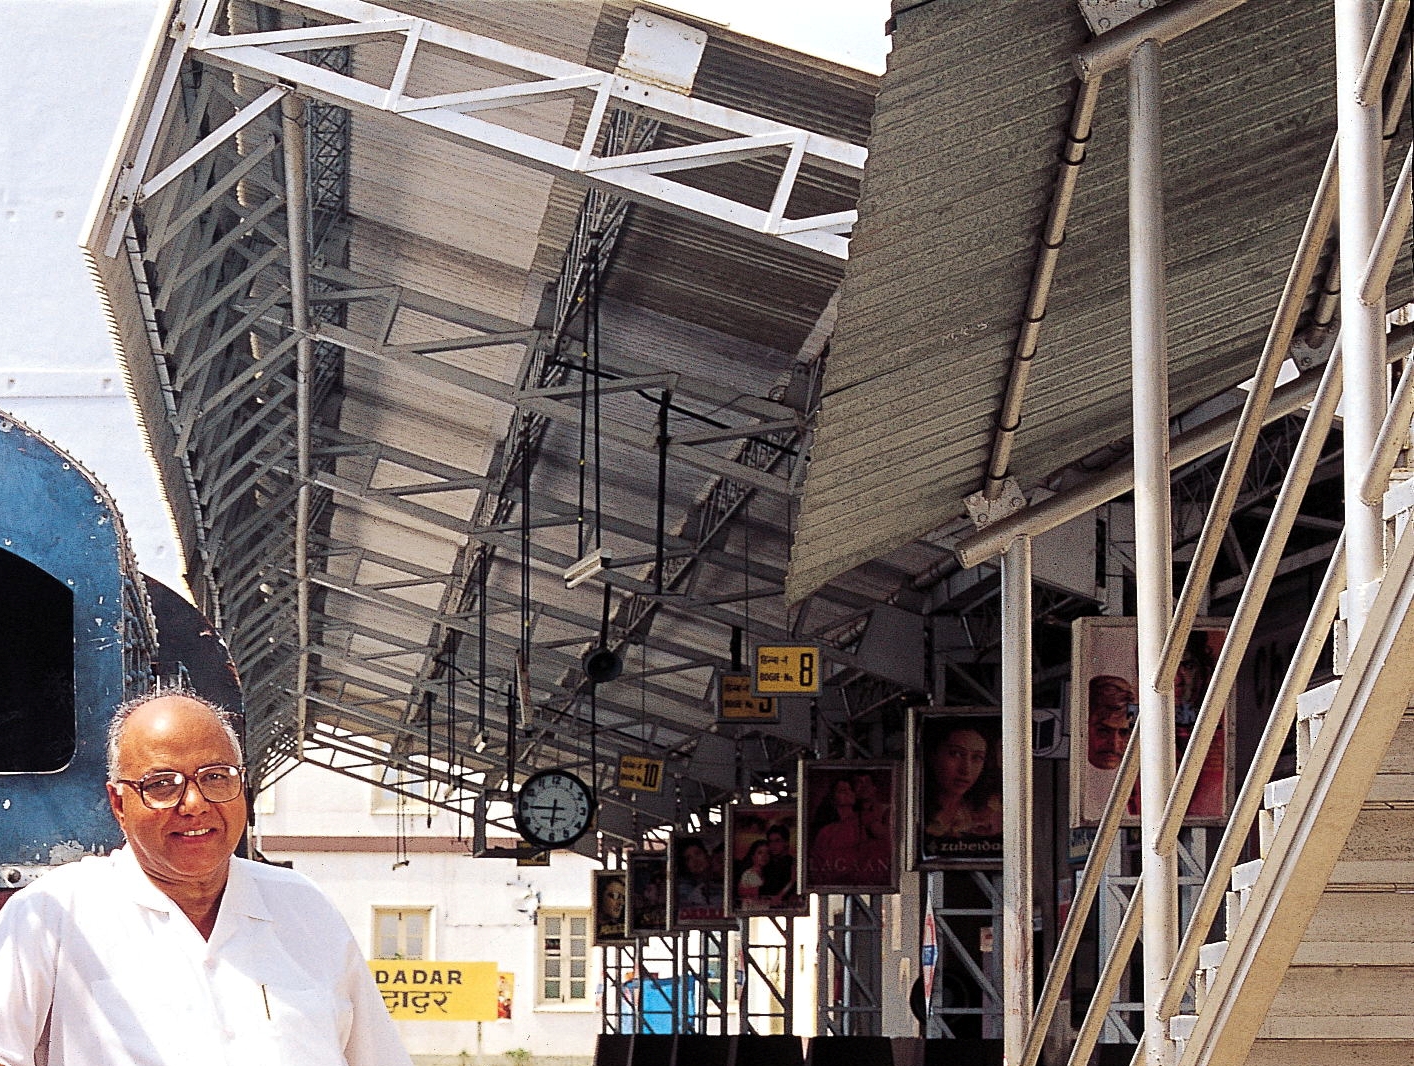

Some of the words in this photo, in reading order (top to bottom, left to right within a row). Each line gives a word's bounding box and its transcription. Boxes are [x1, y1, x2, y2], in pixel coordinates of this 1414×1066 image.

[800, 653, 813, 686] 8
[643, 764, 659, 787] 10
[375, 969, 462, 985] DADAR
[379, 990, 453, 1014] दादर
